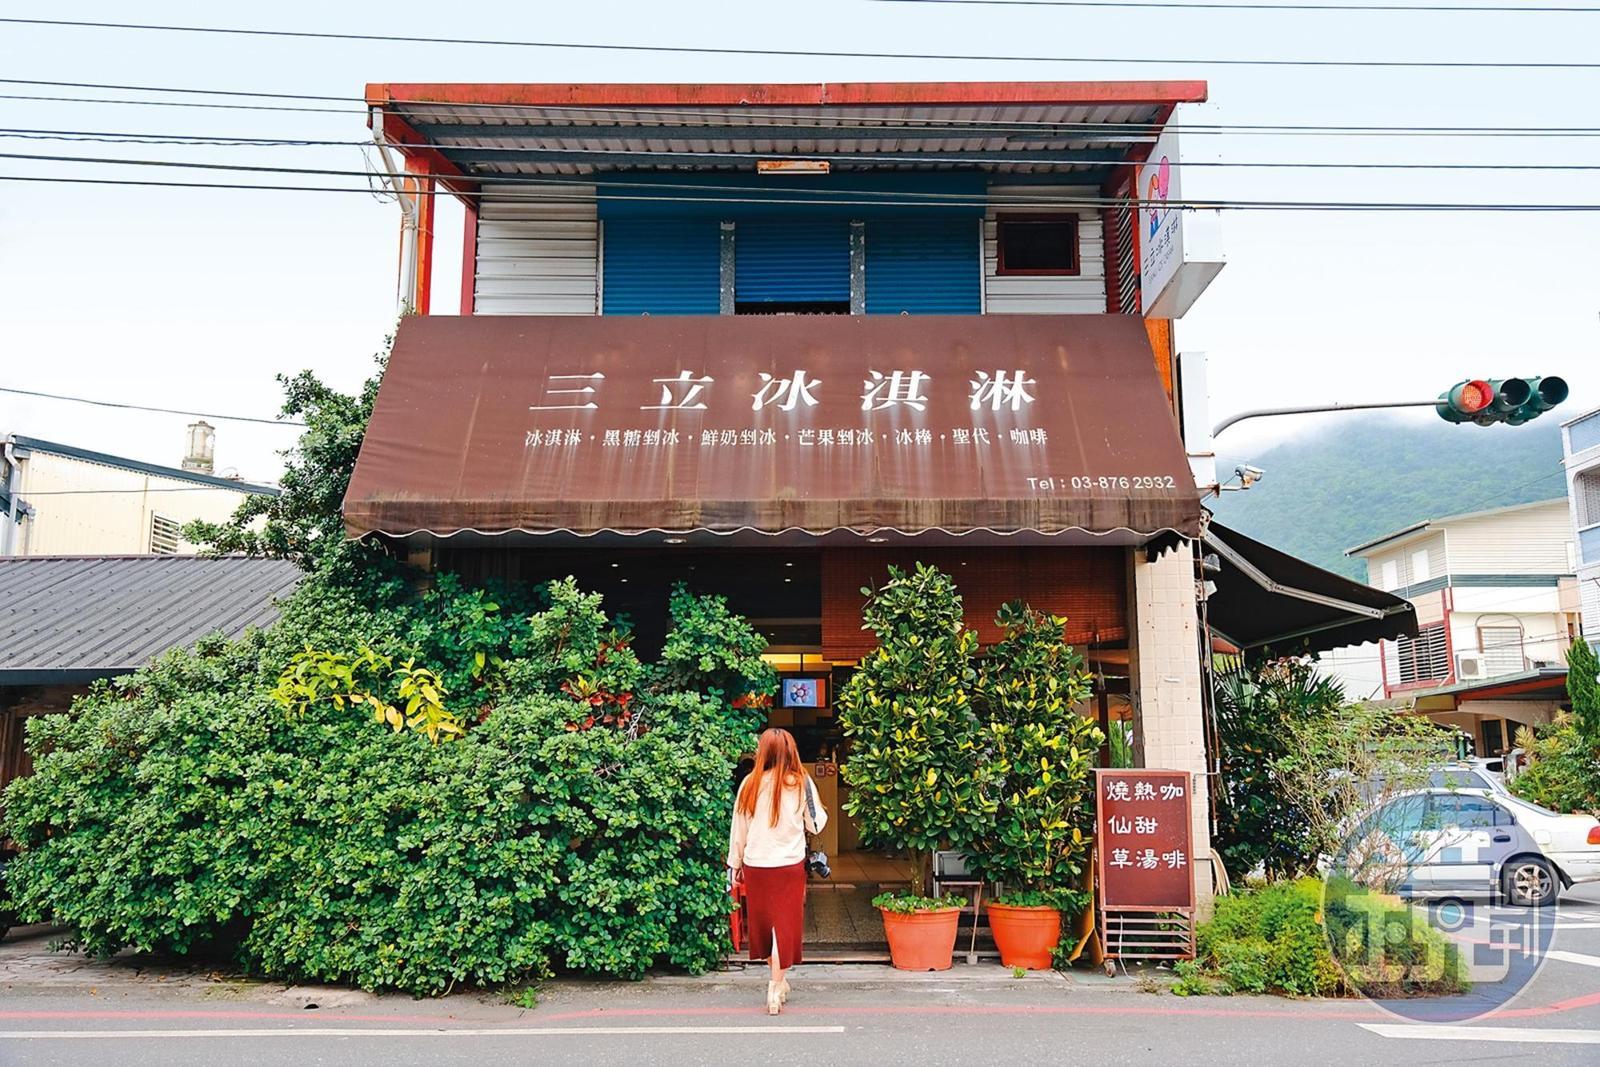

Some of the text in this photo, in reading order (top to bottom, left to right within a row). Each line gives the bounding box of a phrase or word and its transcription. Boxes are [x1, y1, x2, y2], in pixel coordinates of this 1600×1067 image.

[529, 370, 1037, 412] 三立冰淇淋
[524, 428, 583, 447] 冰淇淋
[952, 427, 991, 446] 聖代
[1009, 427, 1048, 446] 咖啡
[1132, 475, 1176, 489] 2932
[1106, 780, 1133, 870] 燒仙草
[1134, 781, 1160, 870] 熱甜湯
[1160, 782, 1188, 870] 咖啡
